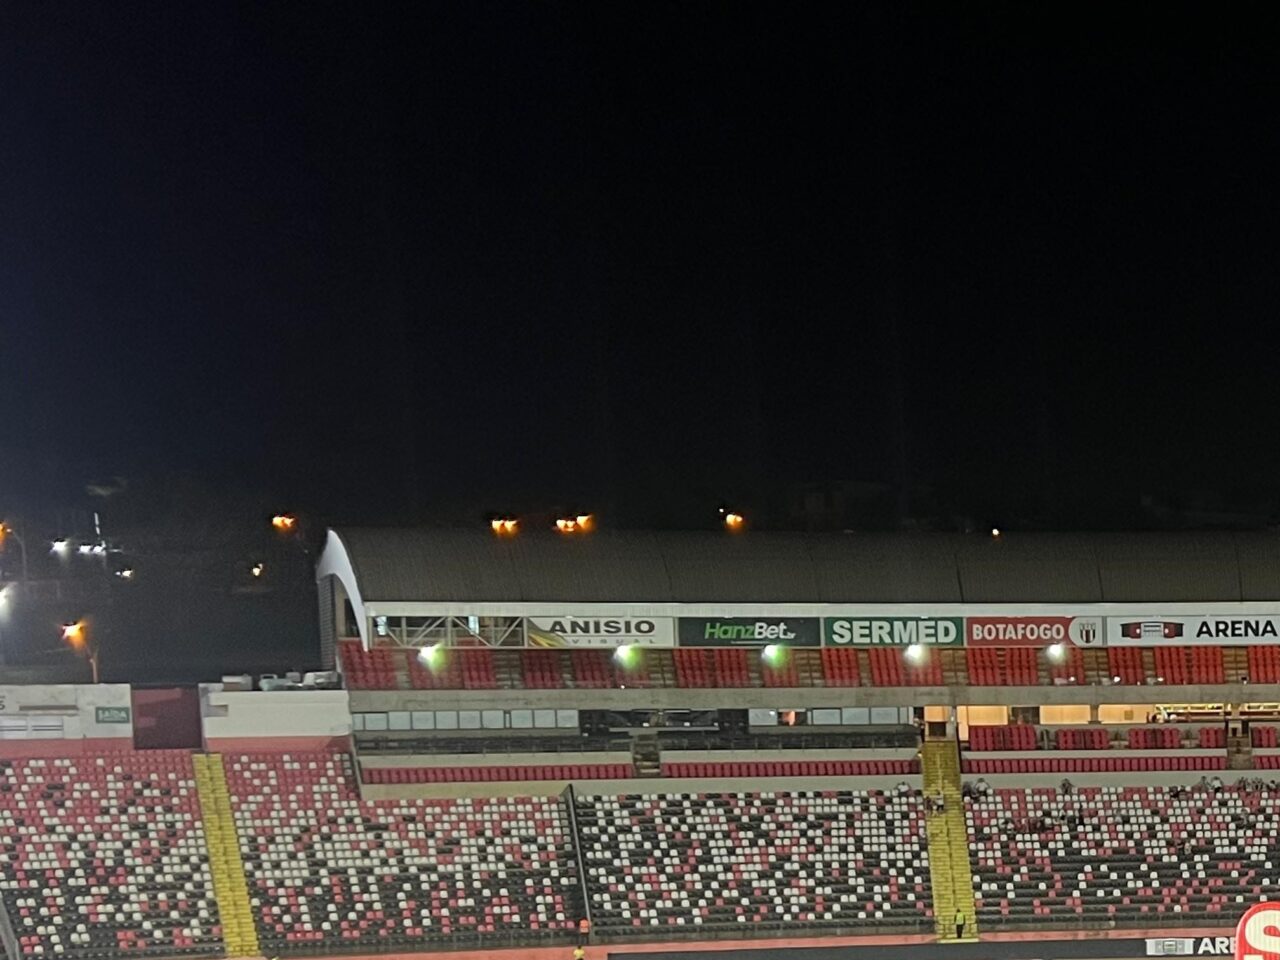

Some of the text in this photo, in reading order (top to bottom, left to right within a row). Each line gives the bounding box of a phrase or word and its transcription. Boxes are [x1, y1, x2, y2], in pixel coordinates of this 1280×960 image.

[550, 619, 656, 634] ANISIO
[831, 621, 958, 644] SERMED
[972, 623, 1065, 641] BOTAFOGO
[1196, 620, 1278, 638] ARENA
[1197, 937, 1237, 955] ARE
